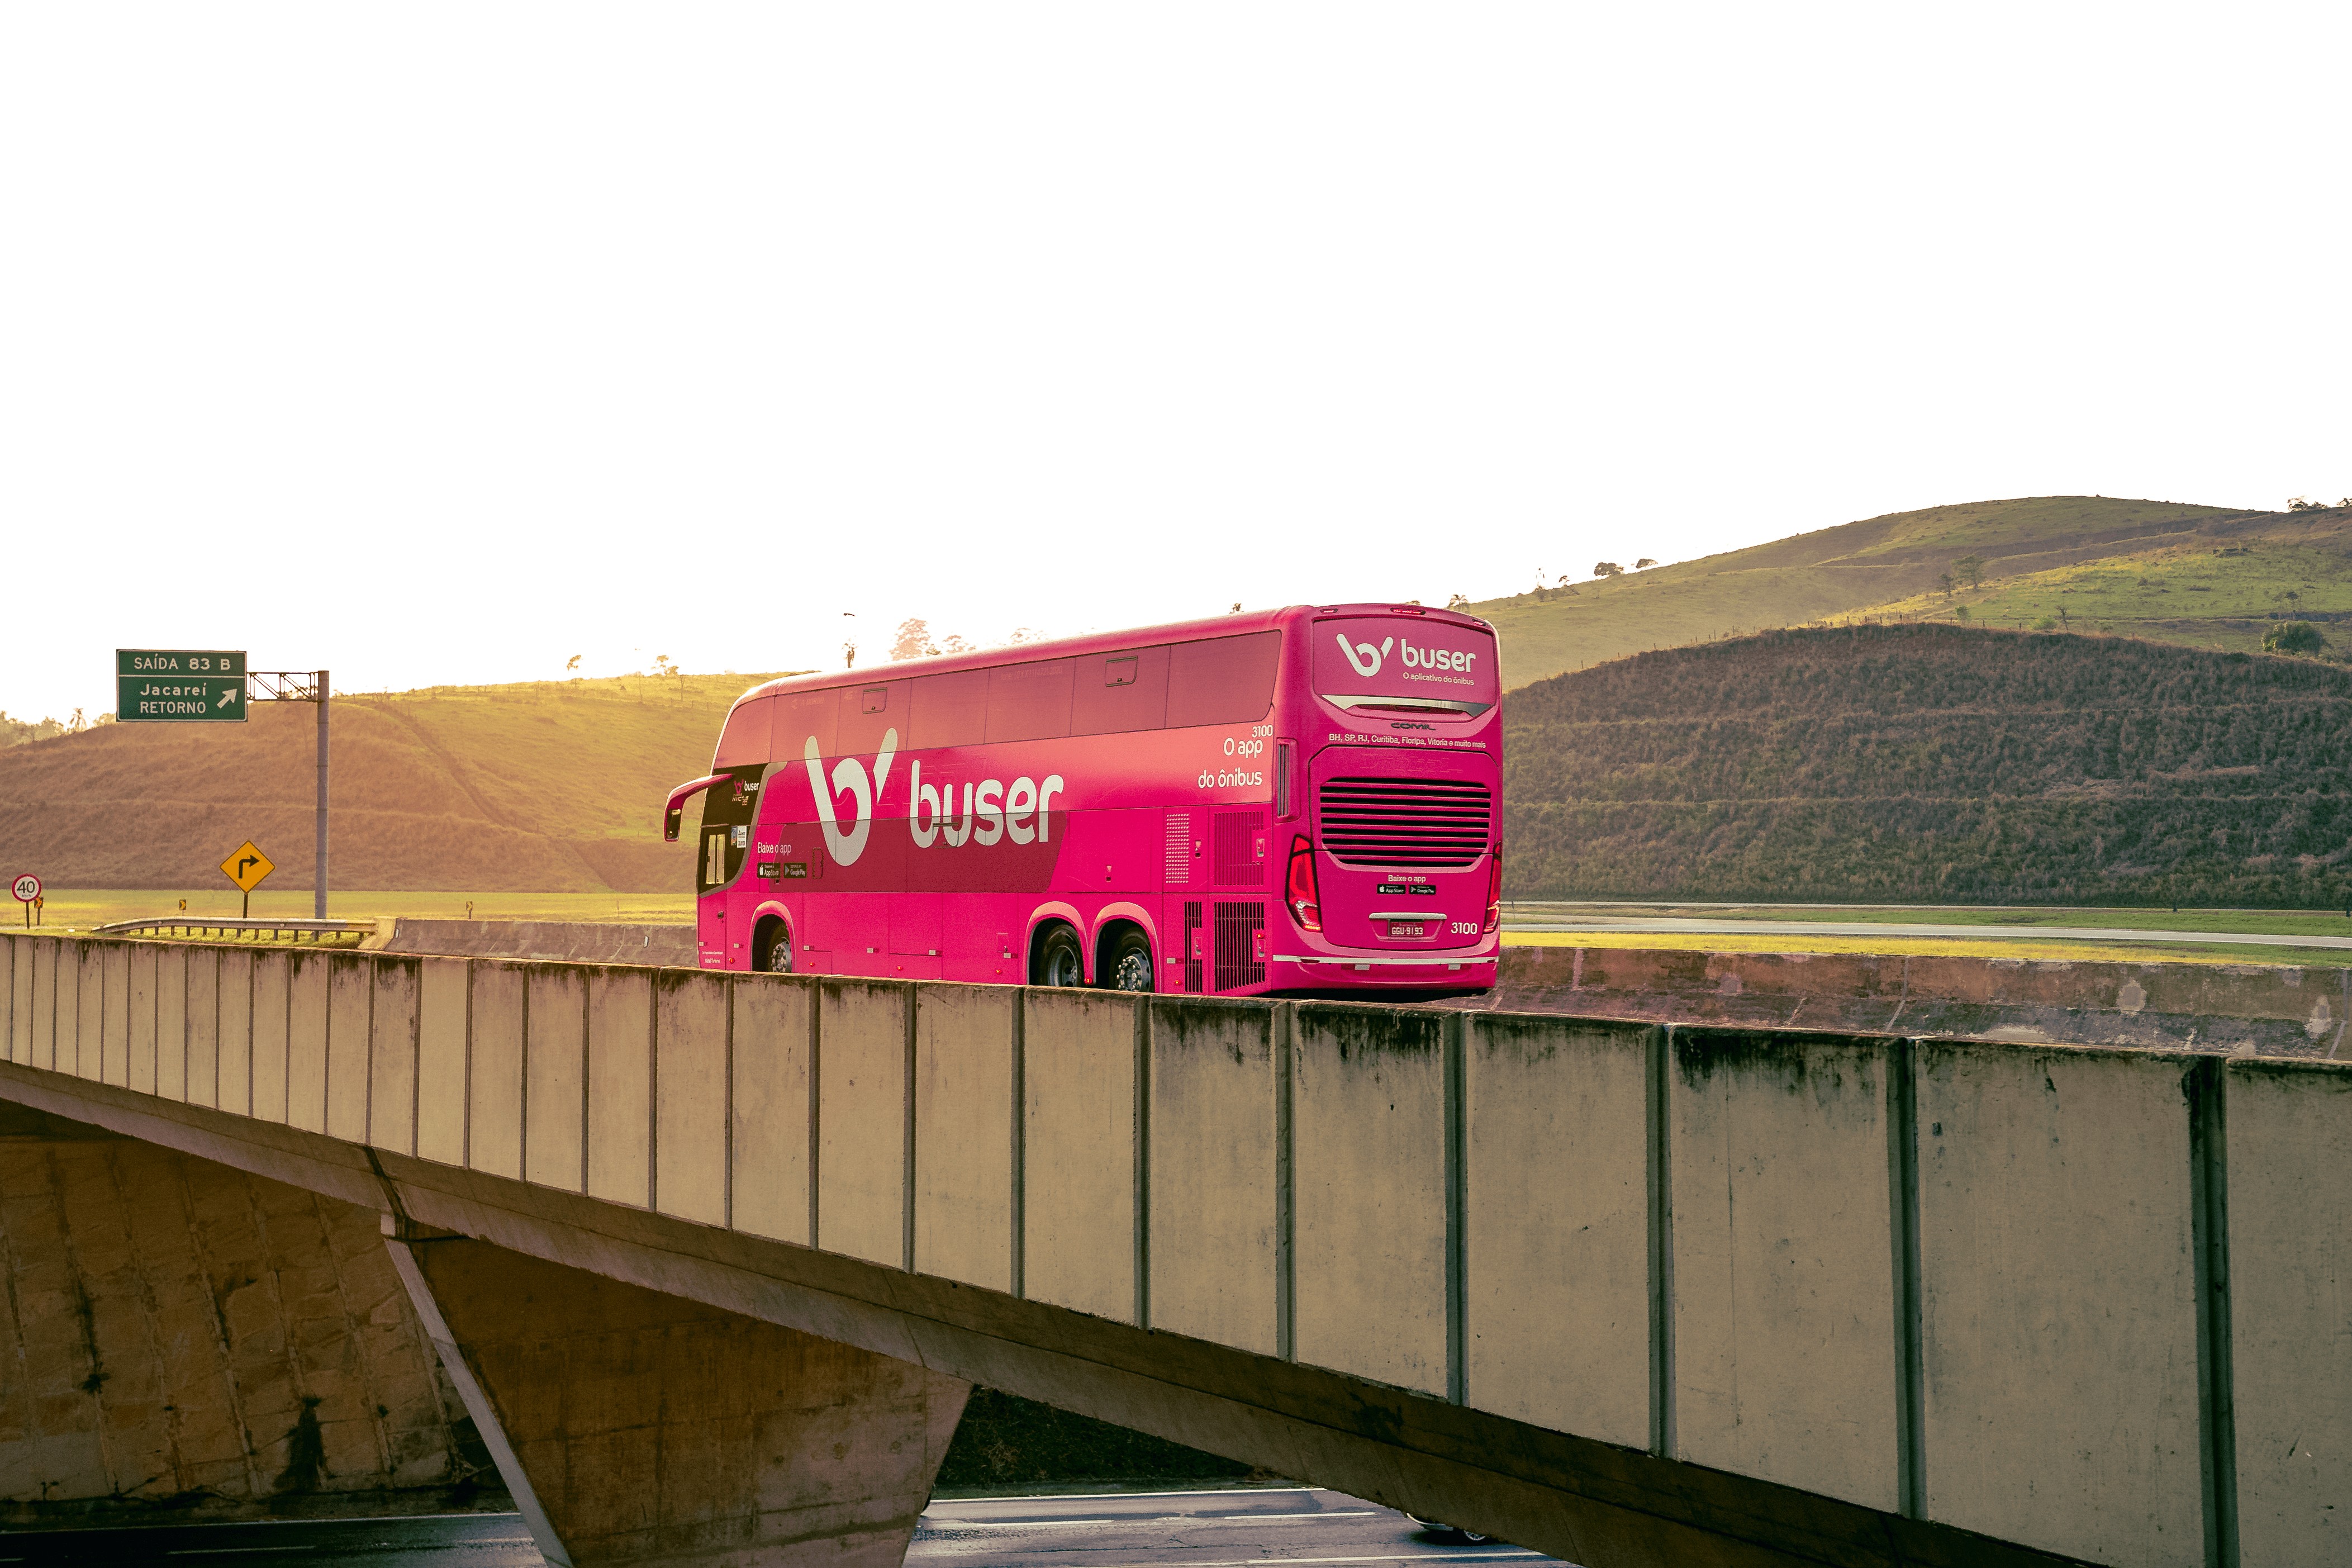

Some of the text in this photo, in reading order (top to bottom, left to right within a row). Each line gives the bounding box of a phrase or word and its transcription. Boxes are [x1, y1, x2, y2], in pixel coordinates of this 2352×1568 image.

[134, 653, 230, 671] SAÍDA 83 B
[1401, 638, 1476, 673] buser
[1410, 672, 1442, 682] aplicativo
[1453, 676, 1475, 686] ônibus
[140, 682, 207, 696] Jacareí
[140, 701, 206, 714] RETORNO
[1252, 724, 1274, 738] 3100
[1391, 722, 1436, 731] COMIL
[1329, 733, 1343, 742] BH,
[1344, 734, 1356, 743] SP,
[1357, 734, 1370, 743] RJ,
[1371, 735, 1400, 744] Curitiba,
[1401, 737, 1427, 745] Floripa,
[1223, 737, 1263, 759] O app
[1198, 767, 1262, 788] do ônibus
[744, 780, 759, 791] buser
[910, 759, 1064, 848] buser
[757, 842, 774, 854] Baixe
[775, 844, 779, 853] o
[780, 844, 792, 856] app
[17, 881, 35, 894] 40
[1391, 926, 1423, 935] GGU-9193
[1450, 922, 1477, 934] 3100
